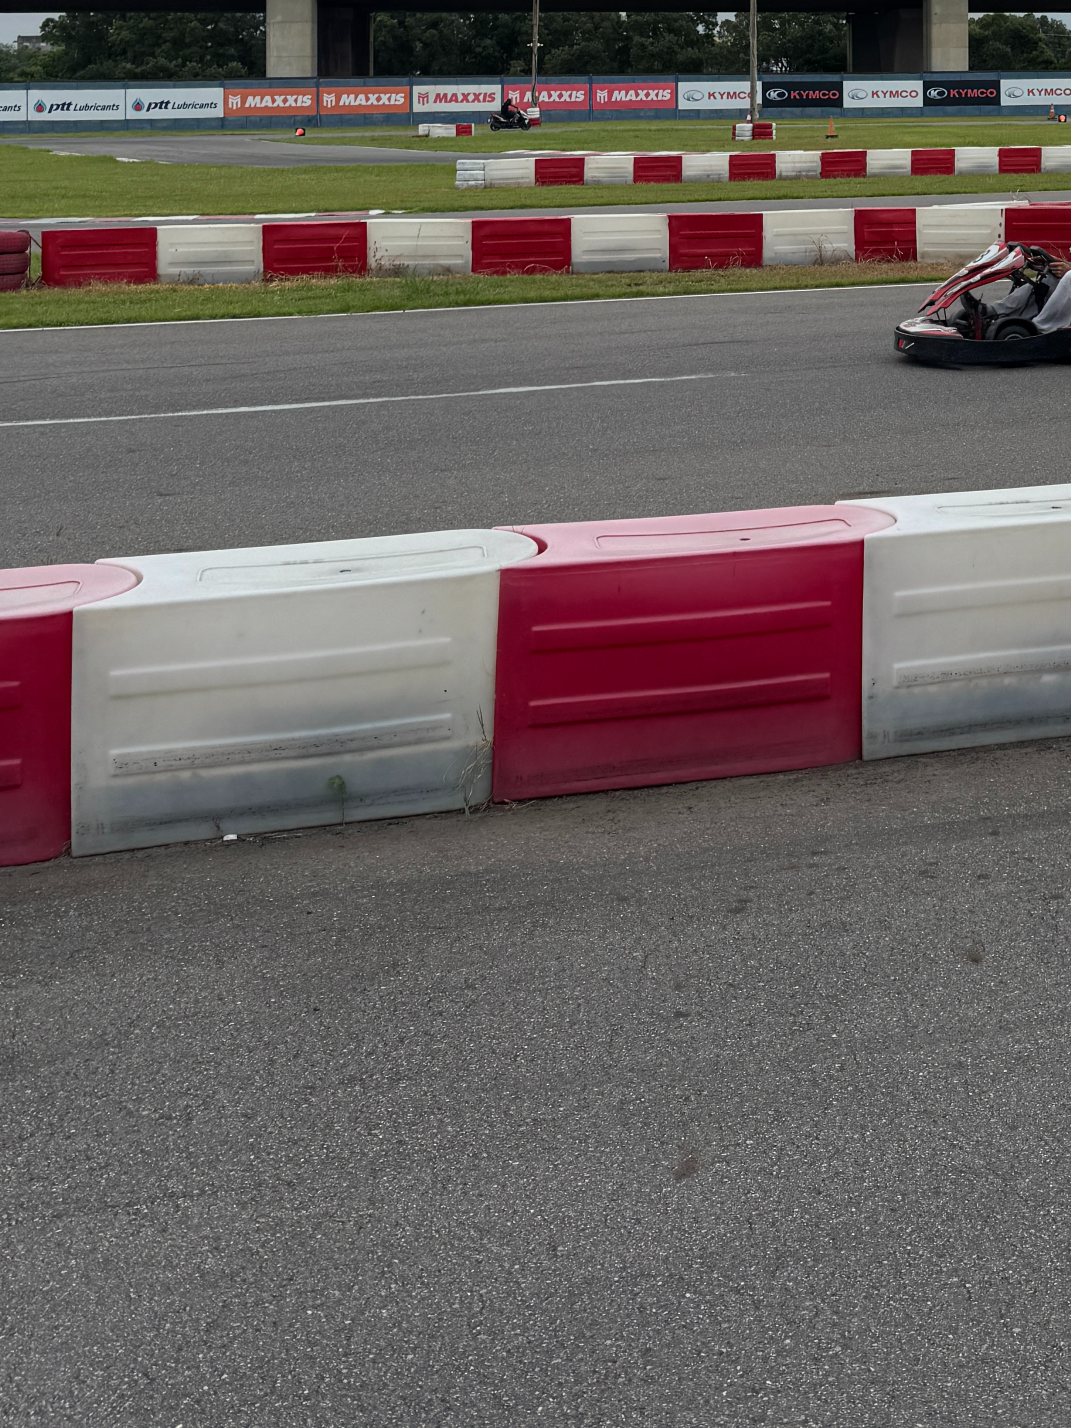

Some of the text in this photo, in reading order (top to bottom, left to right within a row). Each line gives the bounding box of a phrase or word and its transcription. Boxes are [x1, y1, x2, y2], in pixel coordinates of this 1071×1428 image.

[433, 92, 496, 104] MAXXIS
[611, 89, 671, 102] MAXXIS
[790, 90, 839, 100] KYMCO
[871, 90, 919, 99] KYMCO
[950, 88, 997, 98] KYMCO
[1027, 87, 1071, 97] KYMCO
[245, 94, 312, 108] MAXXIS
[339, 93, 405, 106] MAXXIS
[48, 101, 120, 114] ptt Lubricants
[146, 100, 218, 112] ptt Lubricants
